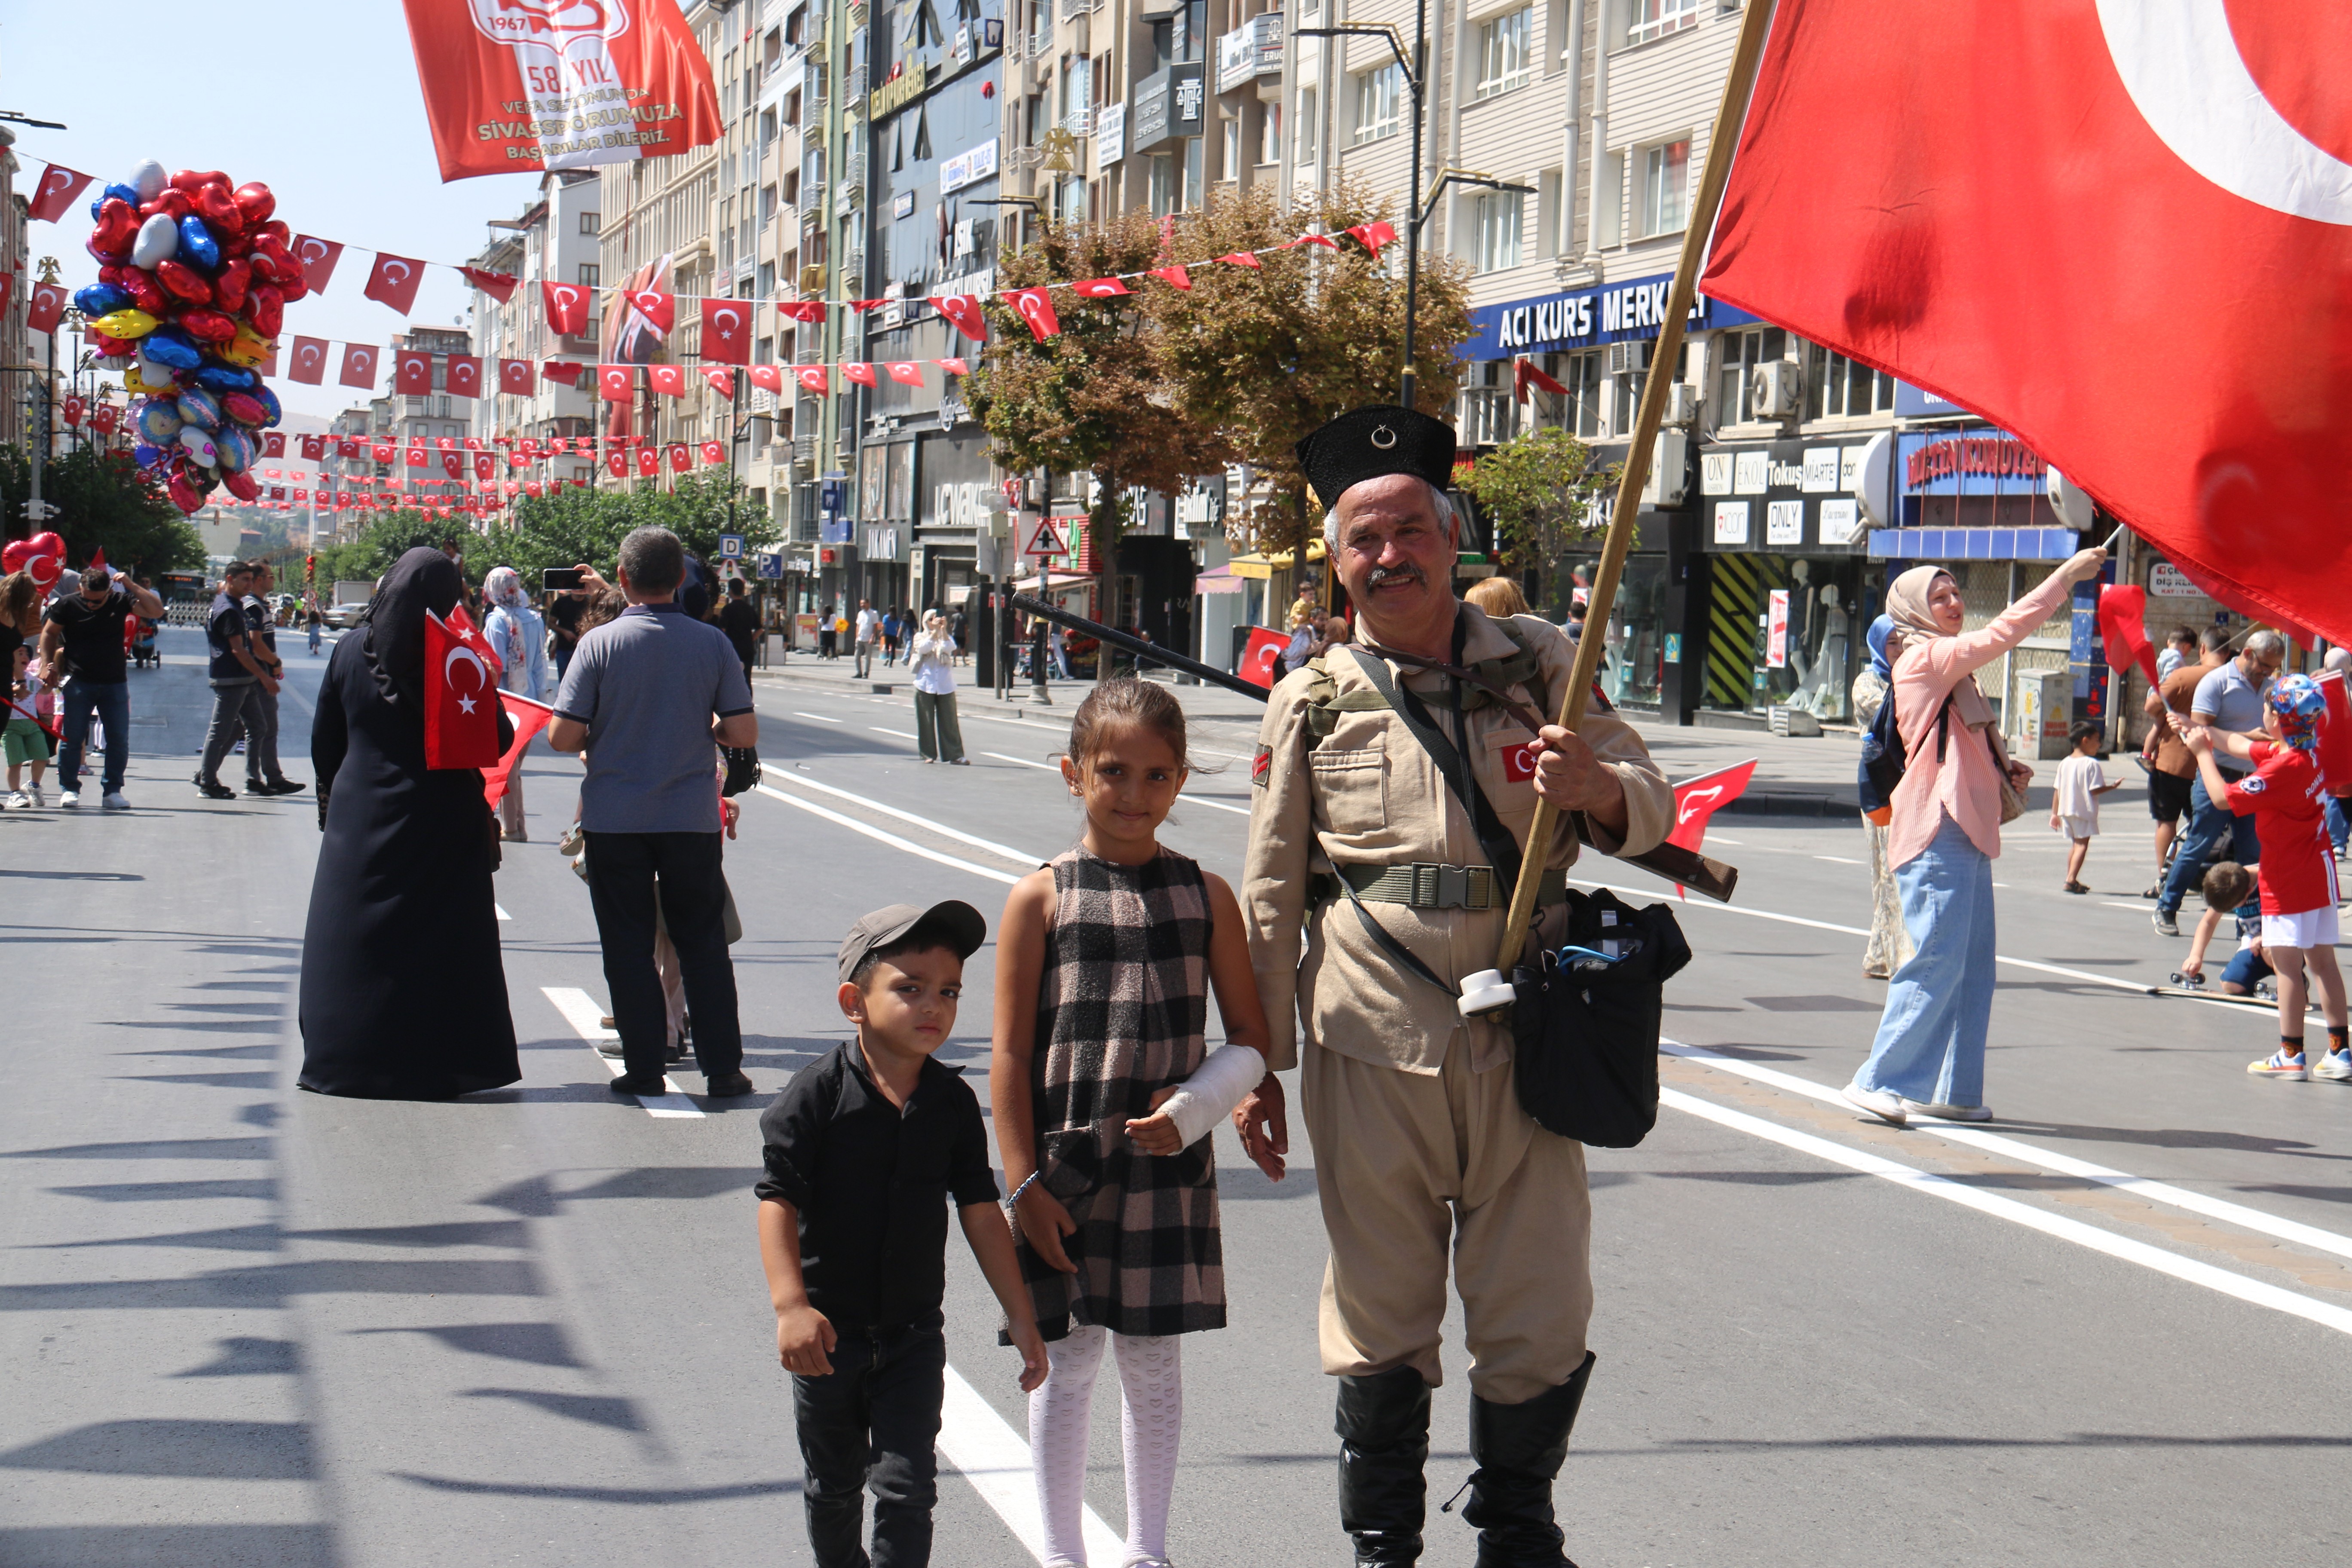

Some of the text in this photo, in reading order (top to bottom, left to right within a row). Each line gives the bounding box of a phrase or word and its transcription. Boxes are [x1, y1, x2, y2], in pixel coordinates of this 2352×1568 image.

[488, 17, 526, 31] 1967
[570, 58, 612, 86] YIL
[502, 87, 650, 115] VEFA SEZONUNDA
[477, 103, 684, 141] SİVASSPORUMUZA
[505, 136, 601, 162] BAŞARILAR
[1499, 309, 1529, 348] AÇI
[1536, 295, 1591, 342] KURS
[1708, 456, 1724, 481] ON
[1738, 461, 1764, 486] EKOL
[1768, 460, 1802, 490] Tokuş
[1771, 505, 1798, 528] ONLY
[727, 540, 736, 553] D
[760, 554, 772, 571] P
[2156, 578, 2172, 587] DİŞ
